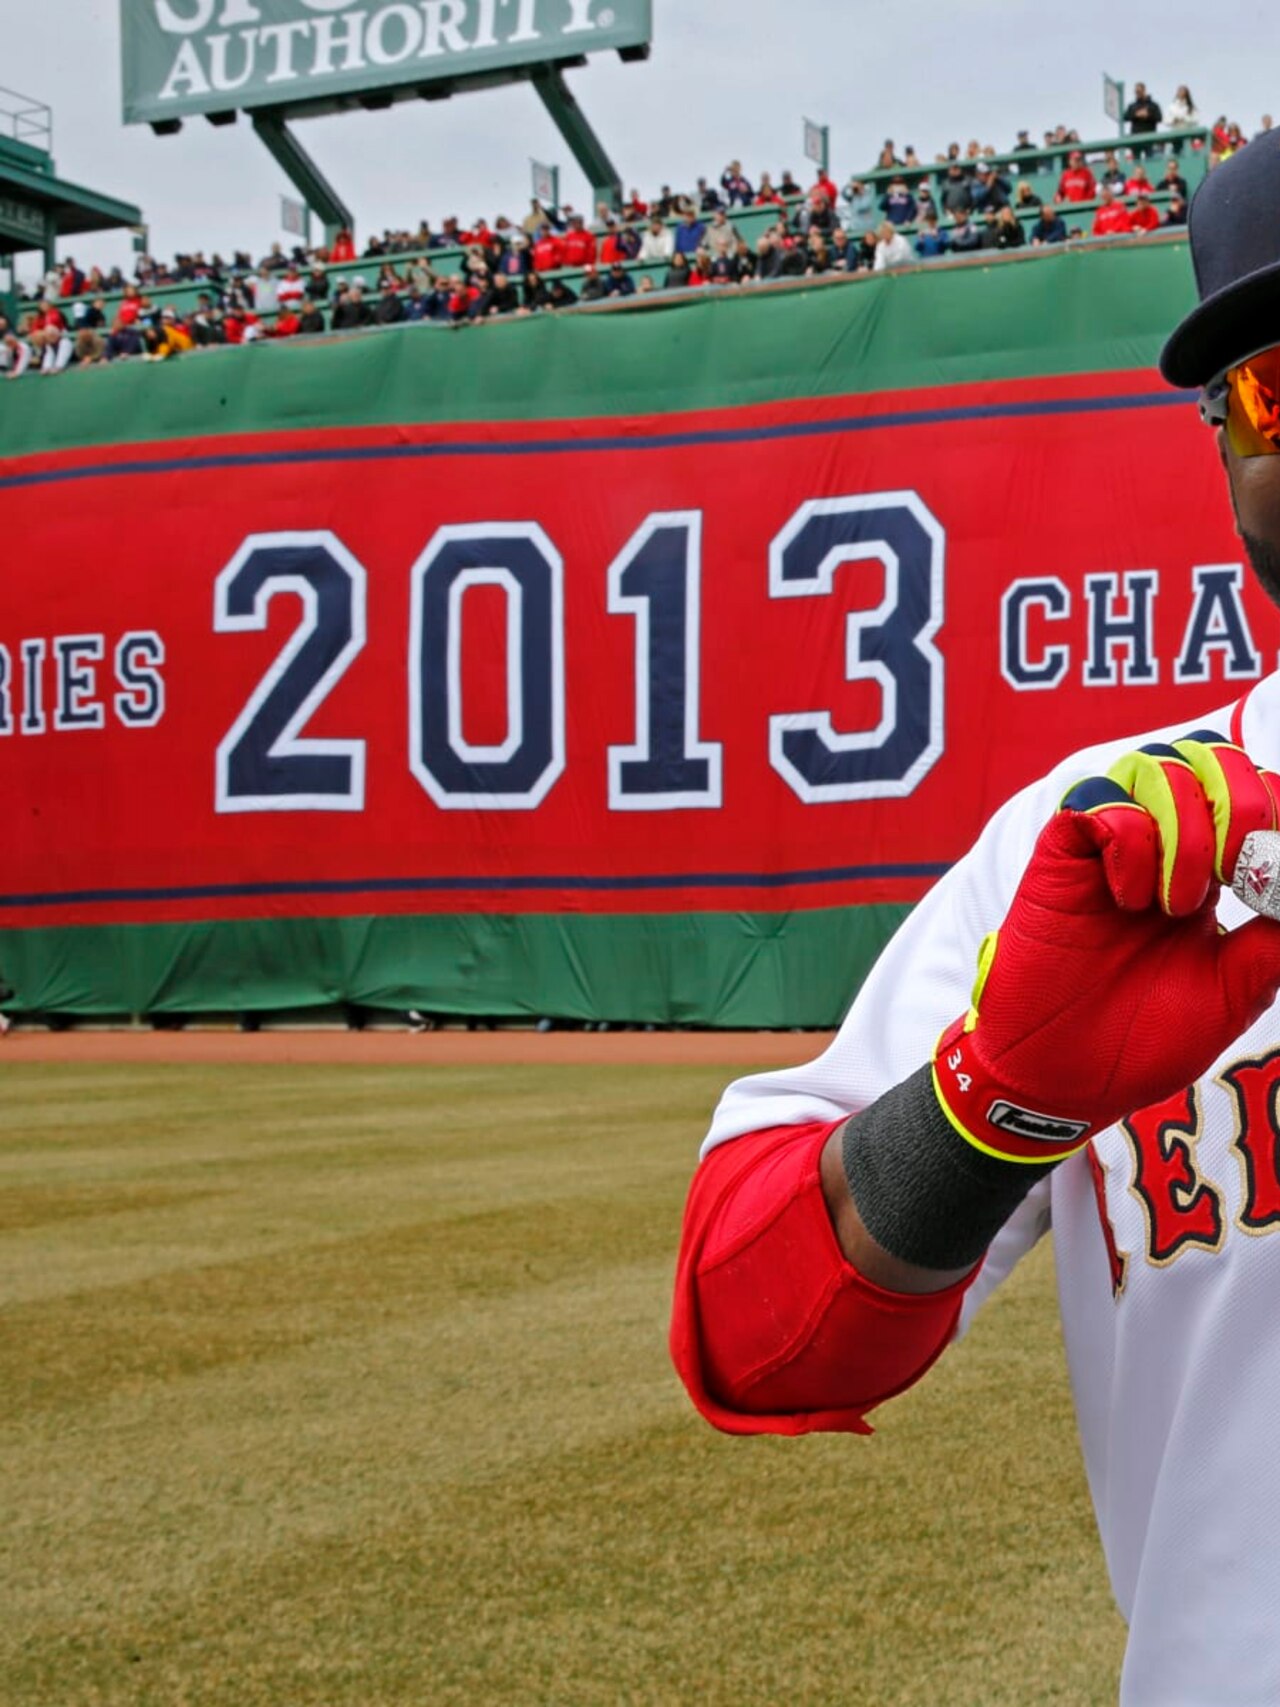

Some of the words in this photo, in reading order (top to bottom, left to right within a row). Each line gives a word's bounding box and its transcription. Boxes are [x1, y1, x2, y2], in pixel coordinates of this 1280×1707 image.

[0, 629, 165, 736] IES
[212, 488, 946, 813] 2013
[947, 1048, 973, 1093] 34
